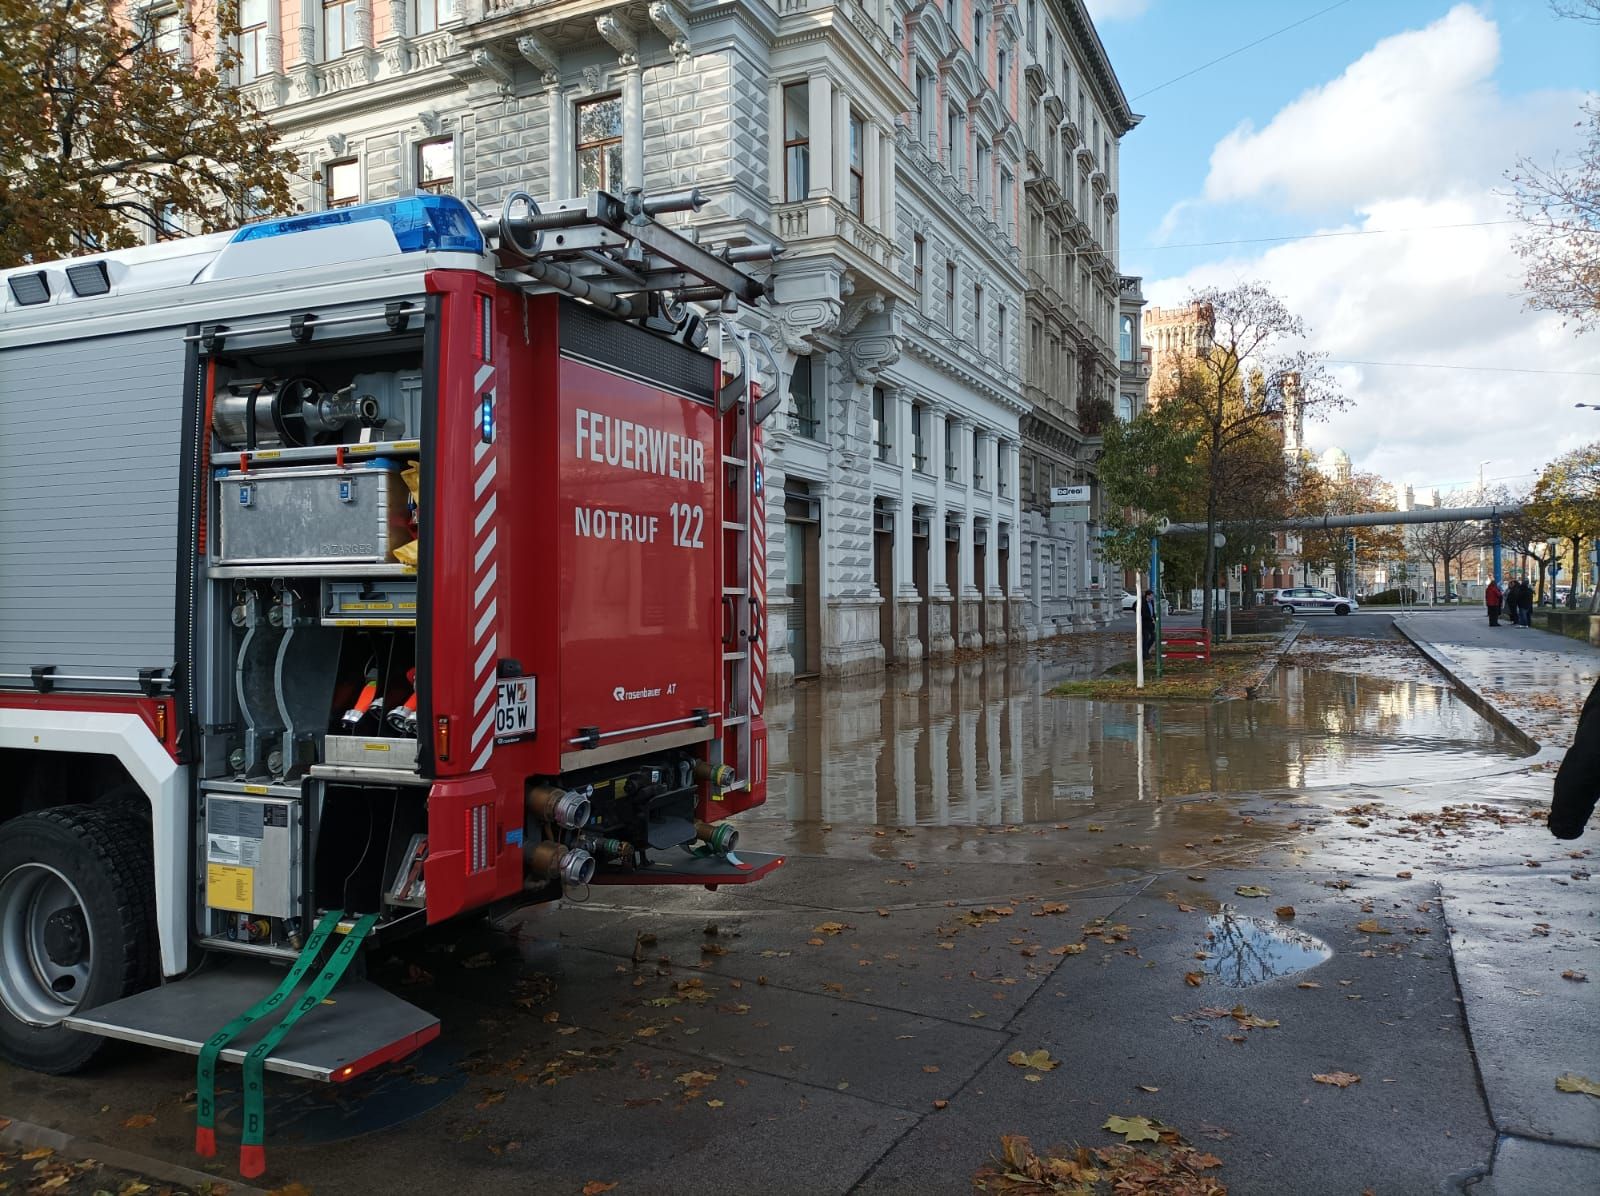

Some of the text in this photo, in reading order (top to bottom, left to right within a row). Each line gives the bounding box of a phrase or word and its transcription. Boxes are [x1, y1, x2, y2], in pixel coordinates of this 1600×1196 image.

[576, 408, 705, 483] FEUERWEHR
[575, 502, 704, 549] NOTRUF 122
[496, 682, 517, 706] FW
[624, 683, 677, 700] rosenbauer AT
[517, 706, 528, 728] W
